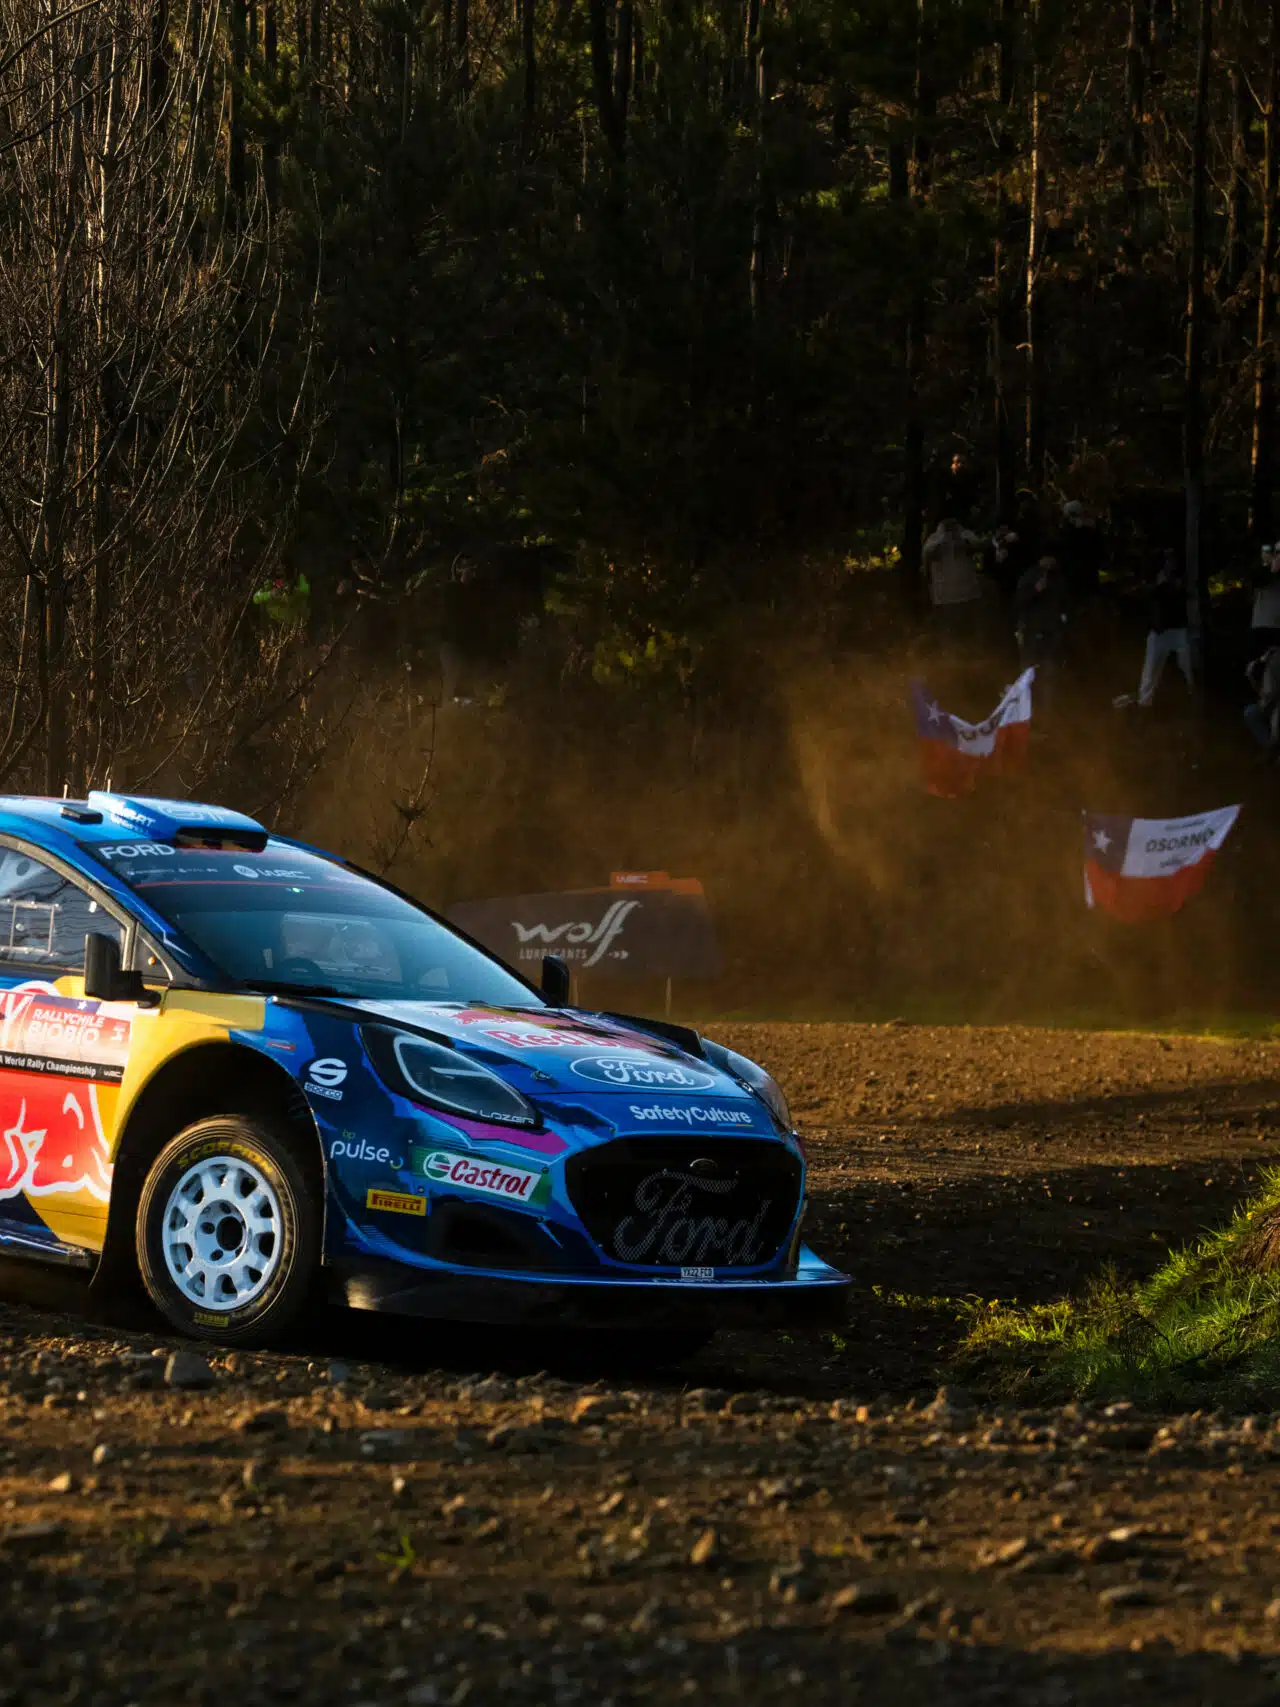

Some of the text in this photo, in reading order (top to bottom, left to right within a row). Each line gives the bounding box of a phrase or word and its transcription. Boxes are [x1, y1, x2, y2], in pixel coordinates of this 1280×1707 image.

[99, 843, 177, 860] FORD
[511, 900, 644, 968] wolf
[4, 1055, 26, 1067] World
[26, 1057, 45, 1071] Rally
[46, 1060, 97, 1079] Championship
[596, 1058, 696, 1086] Ford
[628, 1105, 752, 1125] SafetyCulture
[329, 1138, 390, 1163] pulse
[449, 1160, 533, 1196] Castrol
[372, 1193, 422, 1213] PIRELLI
[613, 1171, 772, 1264] Ford
